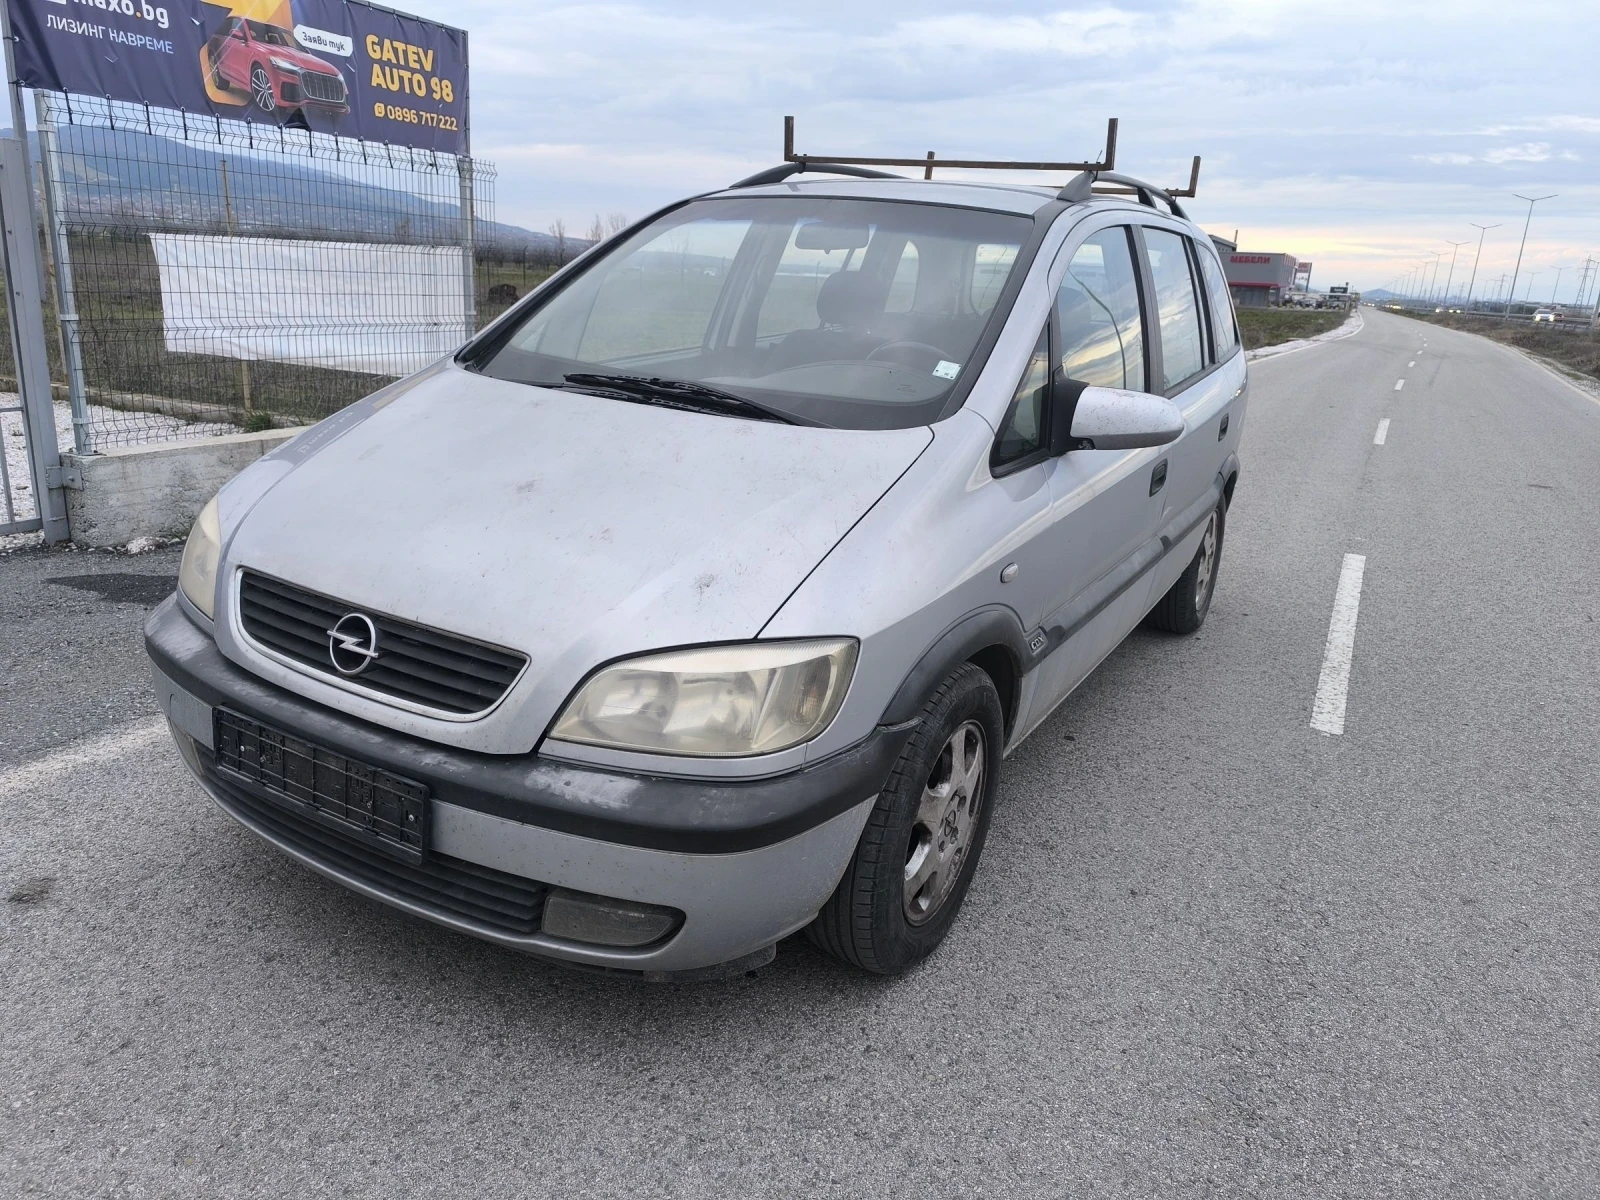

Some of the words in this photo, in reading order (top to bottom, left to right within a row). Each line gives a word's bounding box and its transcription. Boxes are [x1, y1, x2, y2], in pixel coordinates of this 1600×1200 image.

[46, 14, 106, 39] ЛИЗИНГ
[108, 27, 174, 54] НАВРЕМЕ
[329, 40, 346, 52] тук
[365, 34, 434, 72] GATEV
[371, 63, 427, 97] AUTO
[430, 76, 454, 103] 98
[387, 104, 418, 124] 0896
[1230, 255, 1271, 264] МЕБЕЛИ
